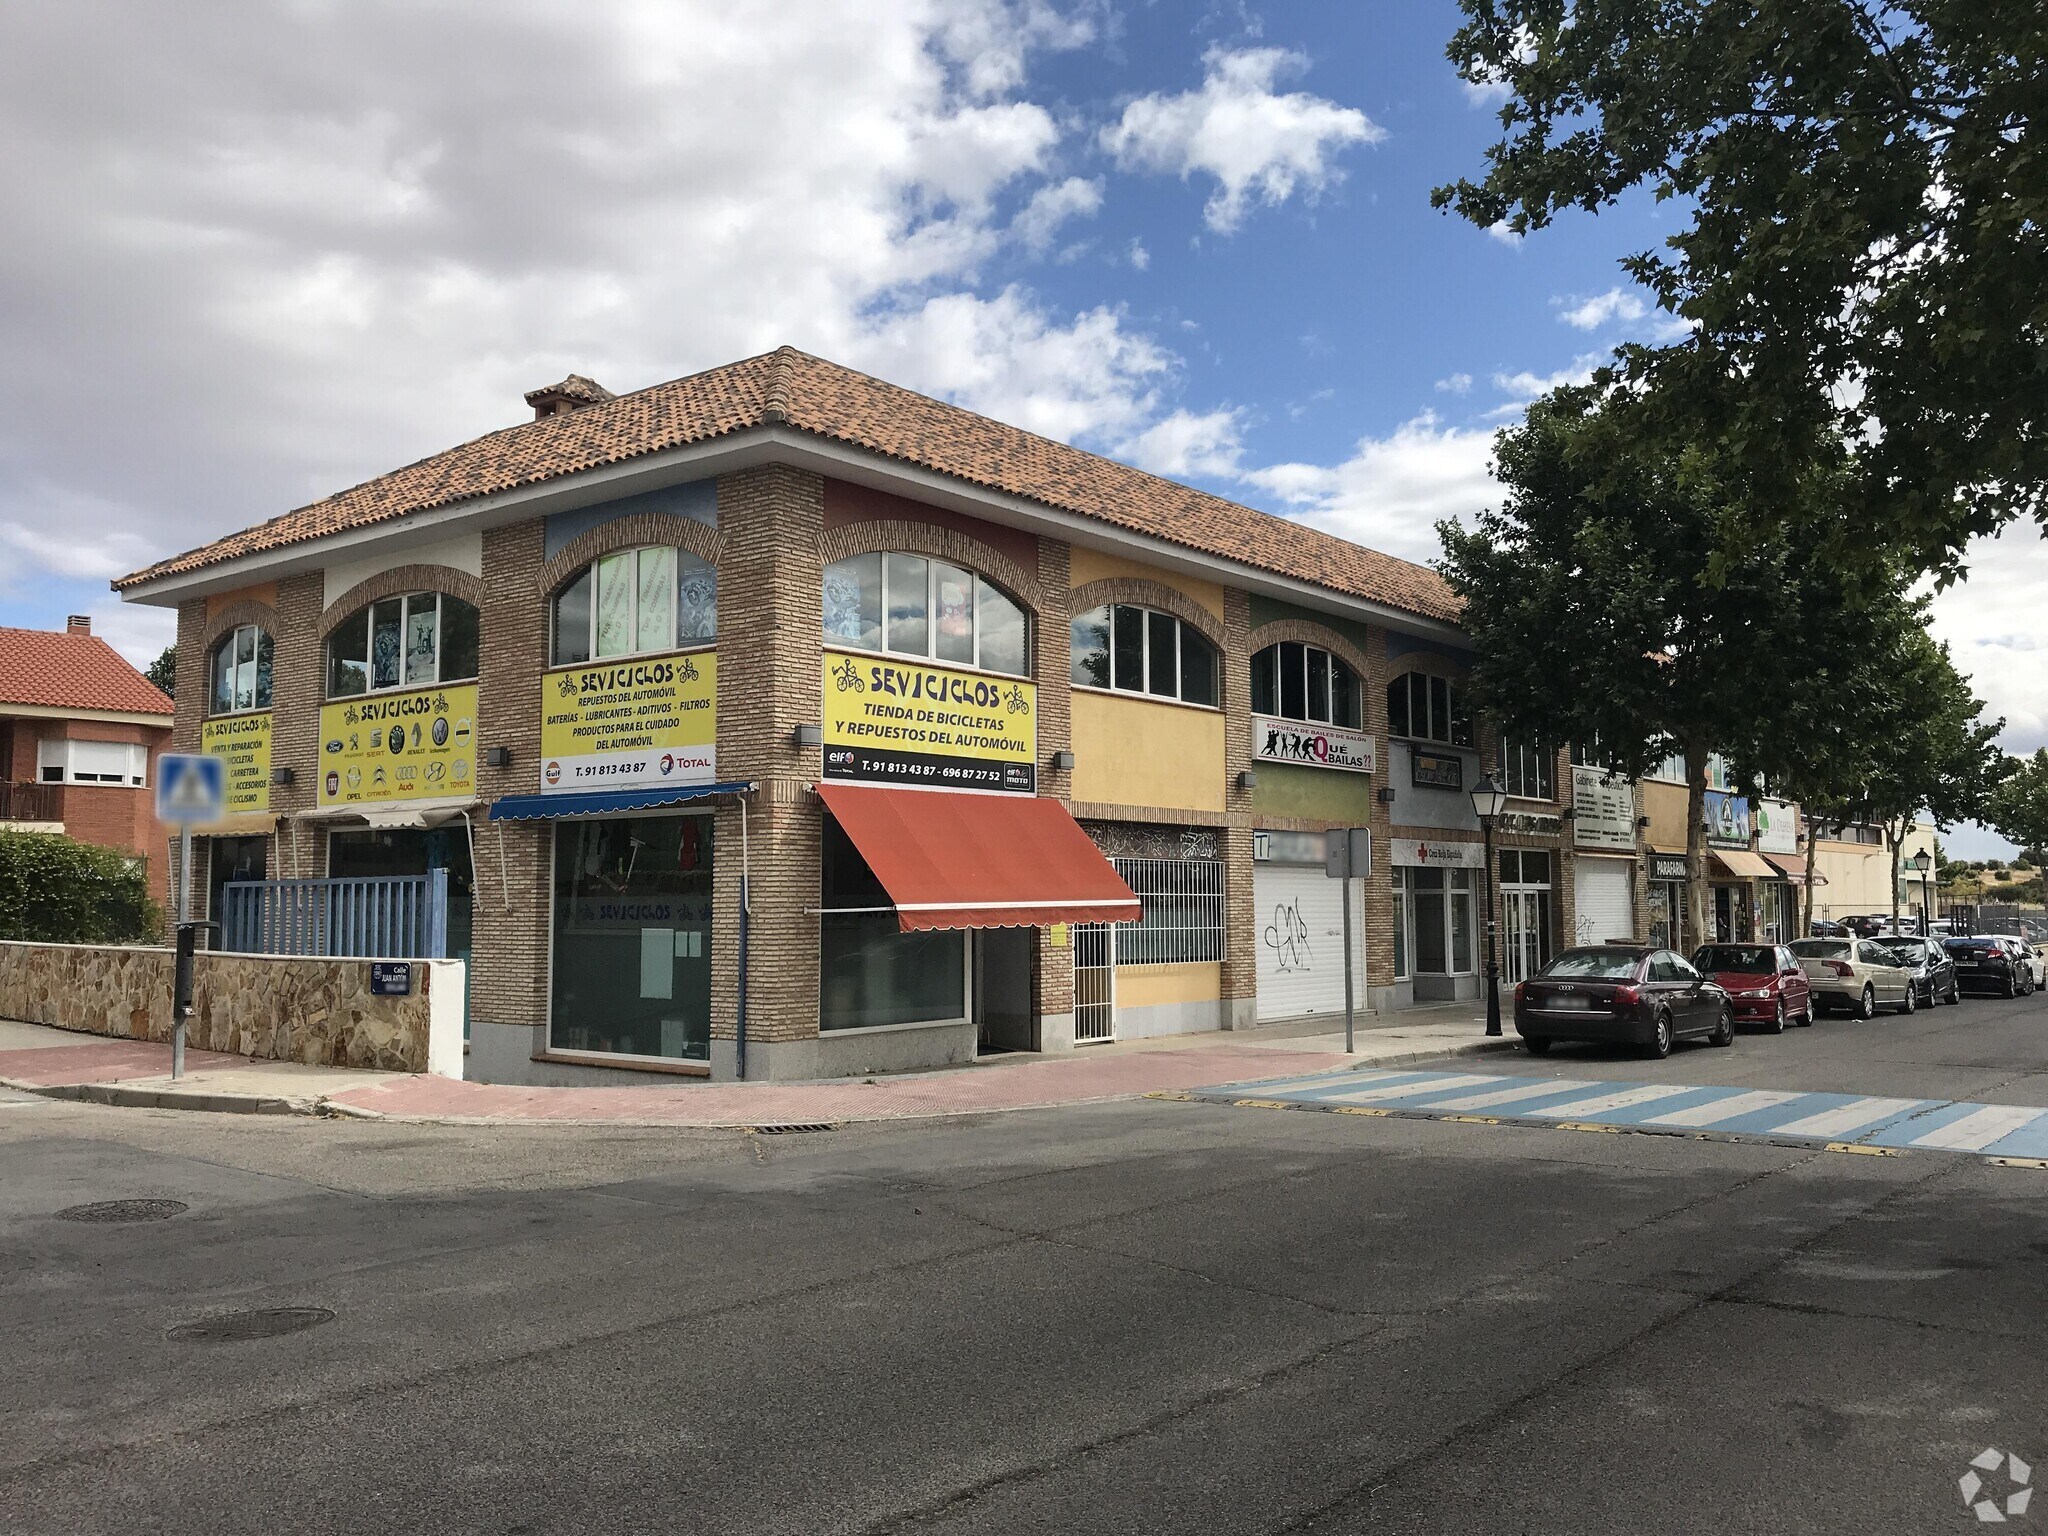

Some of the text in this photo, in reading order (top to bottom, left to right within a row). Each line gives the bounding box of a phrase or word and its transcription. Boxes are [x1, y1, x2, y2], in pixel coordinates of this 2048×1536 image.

[581, 663, 674, 693] SEVICICLOS
[871, 666, 1000, 708] SEVICICLOS
[577, 687, 676, 707] REPUESTOS DEL AUTOMÓVIL
[361, 696, 431, 721] SEVICICLOS
[547, 711, 578, 725] BATERÍAS
[585, 707, 632, 721] LUBRICANTES
[636, 703, 672, 716] ADITIVOS
[679, 699, 710, 711] FILTROS
[864, 703, 1004, 731] TIENDA DE BICICLETAS
[216, 719, 259, 735] SEVICICLOS
[573, 718, 680, 737] PRODUCTOS PARA EL CUIDADO
[1266, 723, 1299, 733] ESCUELA
[1311, 730, 1334, 738] BAILES
[596, 735, 653, 750] DEL AUTOMÓVIL
[835, 720, 1027, 752] Y REPUESTOS DEL AUTOMÓVIL
[211, 739, 263, 753] VENTA Y REPARACIÓN
[677, 758, 711, 769] TOTAL
[829, 752, 846, 763] elf
[230, 767, 259, 778] CARRETERA
[546, 770, 561, 778] Gulf
[575, 762, 647, 777] T. 91 813 43 87
[862, 760, 871, 771] T.
[872, 761, 886, 772] 91
[887, 762, 907, 774] 813
[909, 764, 922, 775] 43
[923, 766, 936, 776] 87
[942, 768, 961, 778] 696
[962, 769, 974, 779] 87
[975, 770, 988, 780] 27
[988, 771, 1001, 781] 52
[235, 779, 267, 790] ACCESORIOS
[233, 793, 258, 804] CICLISMO
[346, 793, 362, 801] OPEL
[393, 966, 407, 974] Calle
